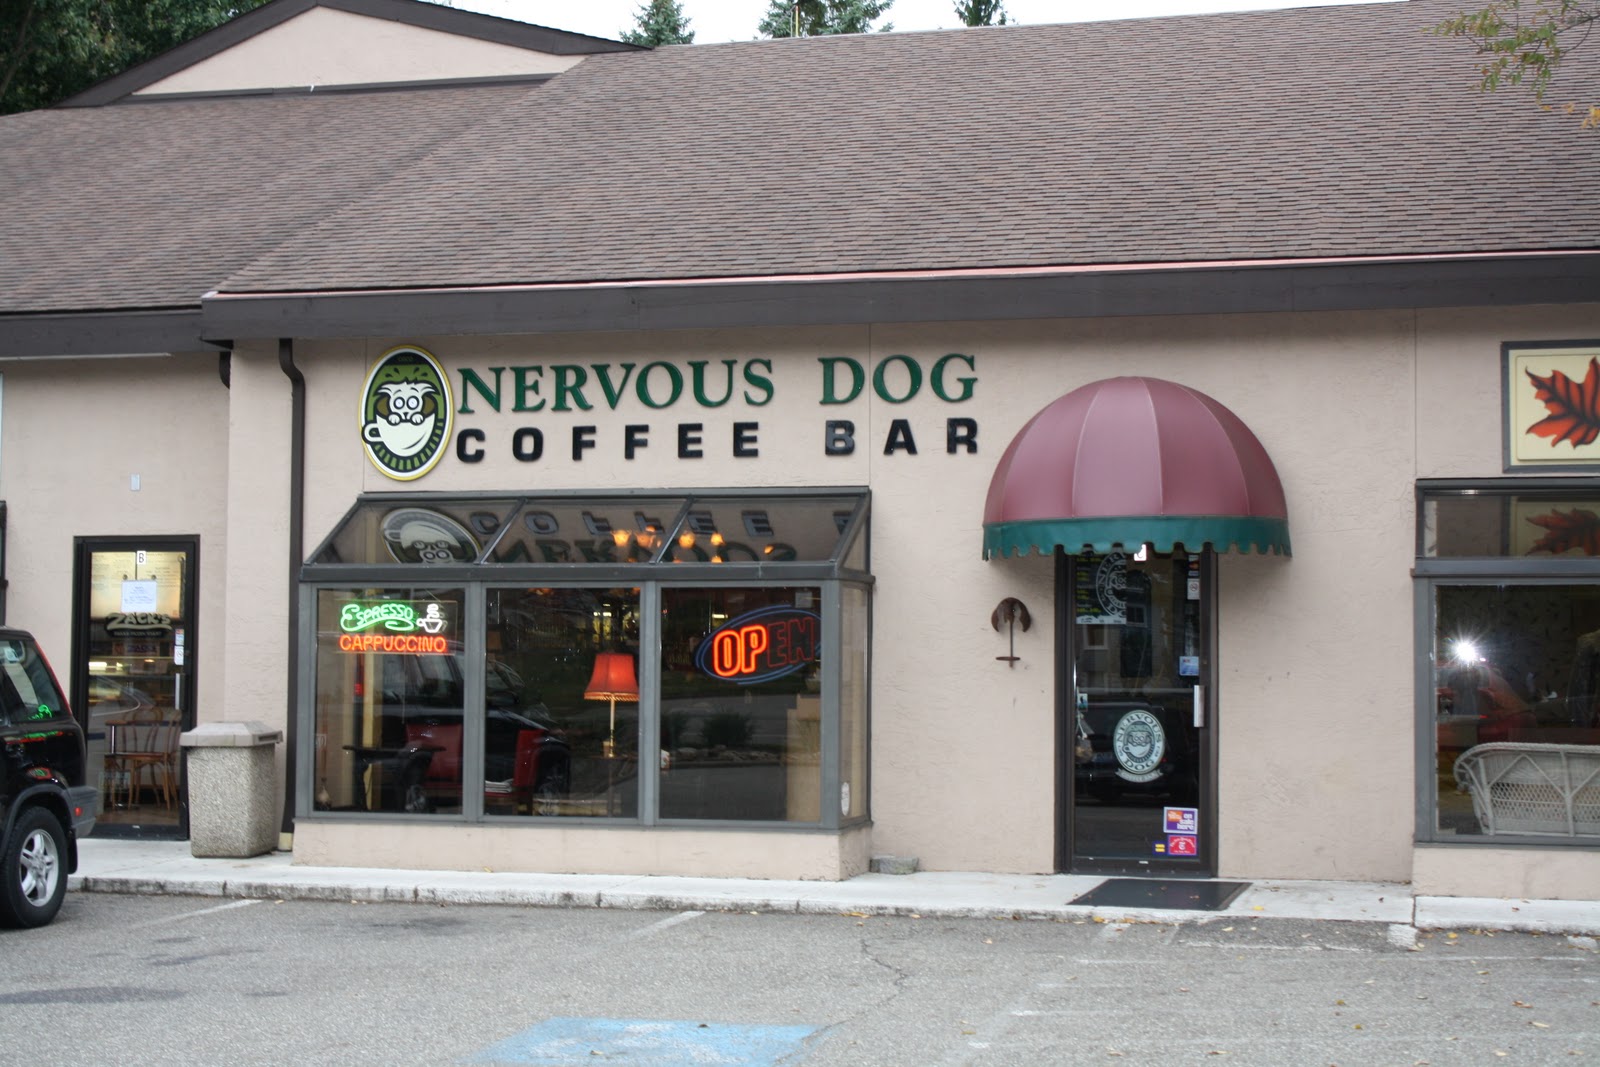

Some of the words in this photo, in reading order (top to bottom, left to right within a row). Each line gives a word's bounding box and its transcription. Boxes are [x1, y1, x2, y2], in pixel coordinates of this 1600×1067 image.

[457, 358, 775, 414] NERVOUS
[817, 353, 978, 405] DOG
[456, 422, 759, 463] COFFEE
[825, 417, 978, 456] BAR
[138, 552, 144, 563] B
[339, 634, 447, 653] CAPPUCCINO
[713, 616, 815, 677] OPEN
[1116, 713, 1162, 744] NERVOUS
[1124, 759, 1154, 770] DOG
